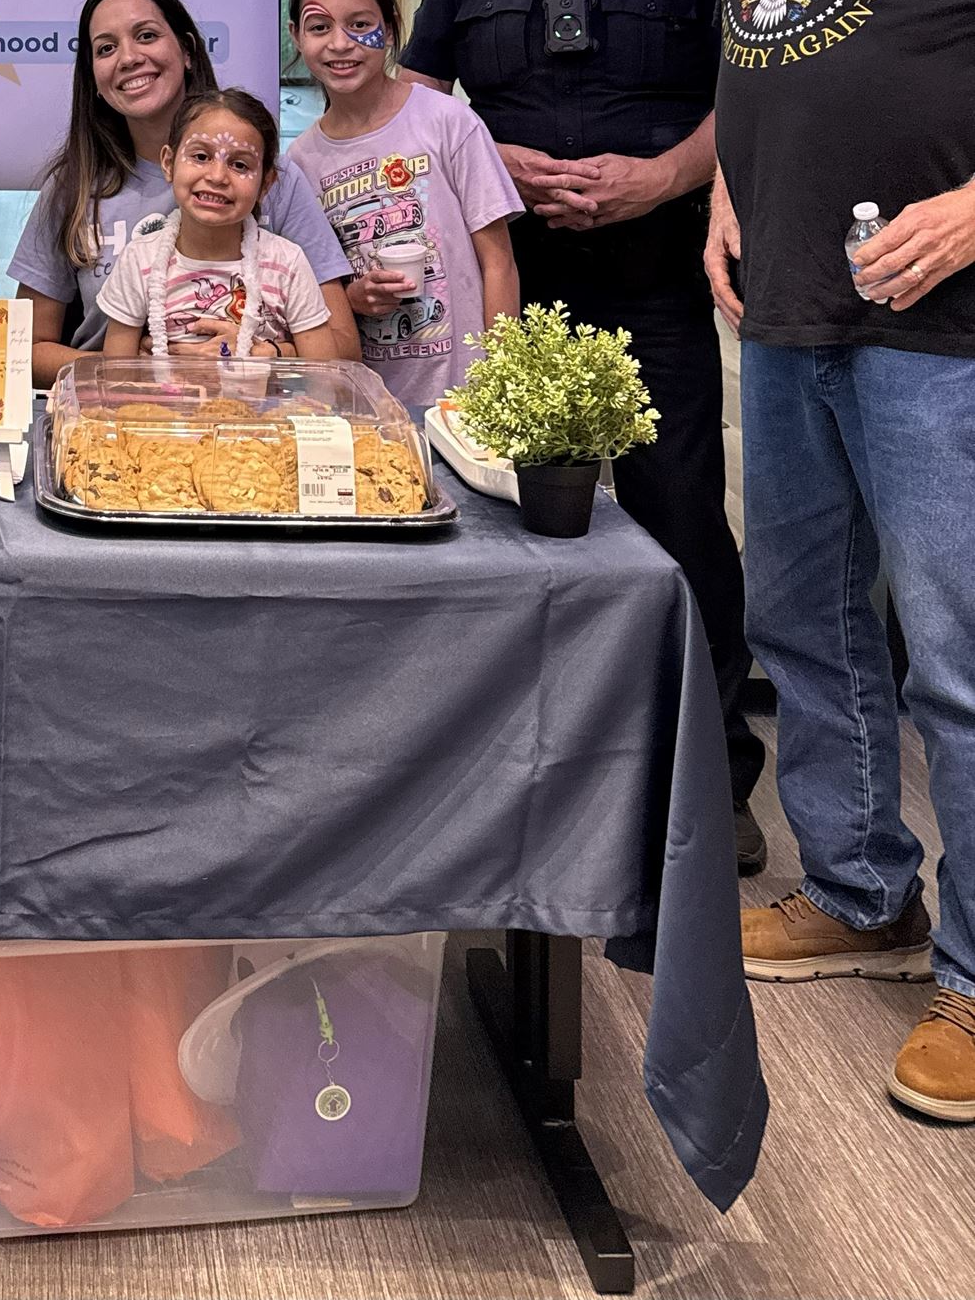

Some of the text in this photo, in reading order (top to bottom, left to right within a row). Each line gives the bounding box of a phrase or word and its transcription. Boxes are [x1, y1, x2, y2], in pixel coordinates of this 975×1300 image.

[725, 0, 874, 69] LTHY AGAIN
[320, 158, 377, 188] TOP SPEED
[388, 338, 453, 358] LEGEND
